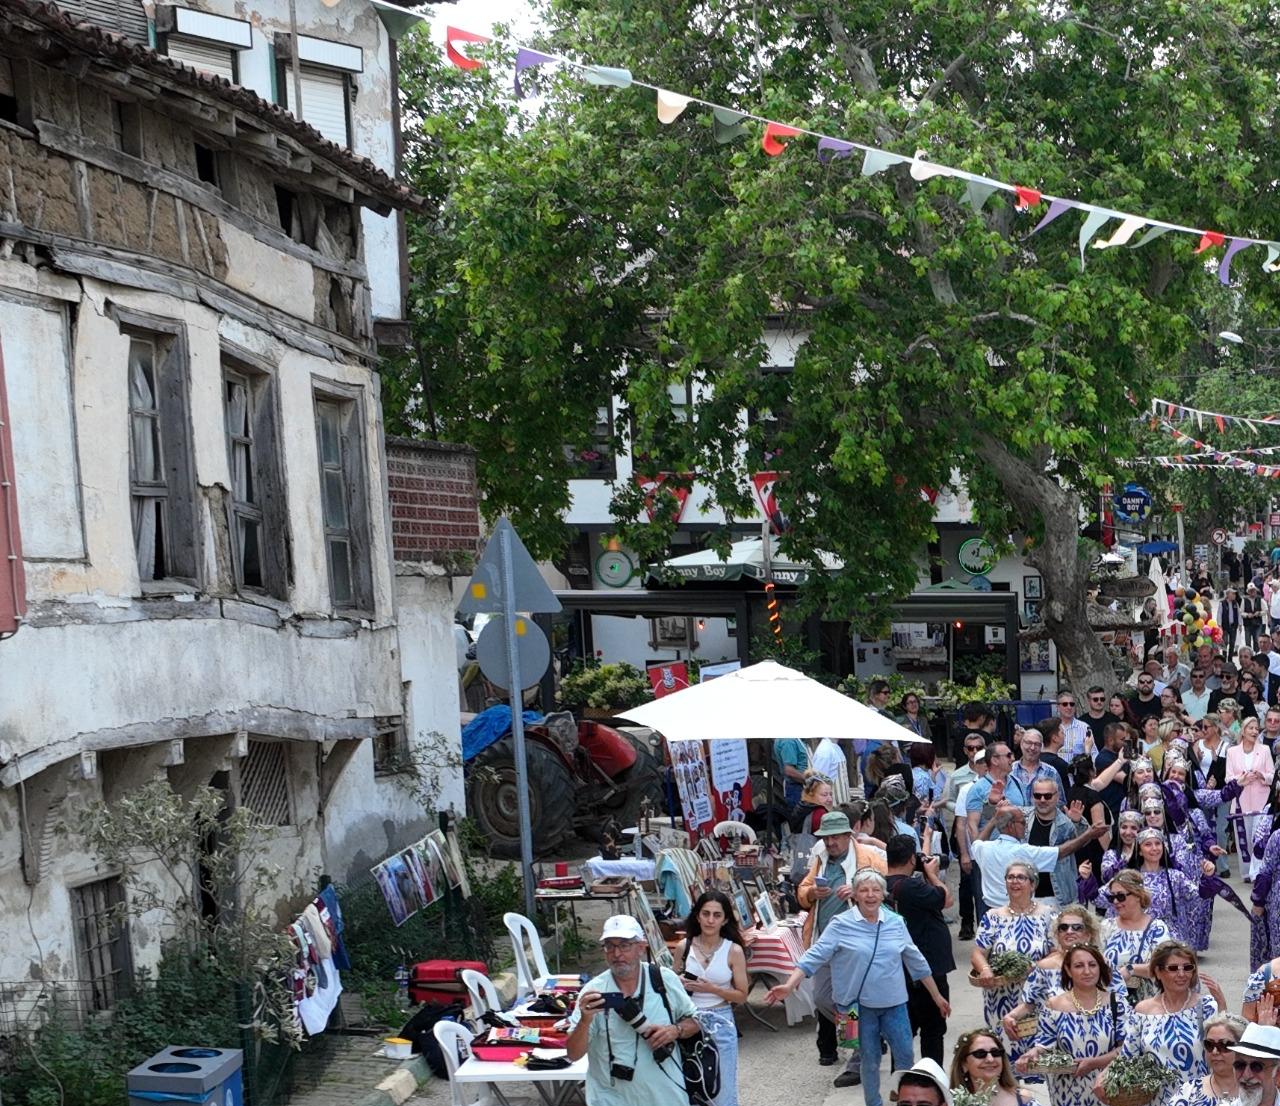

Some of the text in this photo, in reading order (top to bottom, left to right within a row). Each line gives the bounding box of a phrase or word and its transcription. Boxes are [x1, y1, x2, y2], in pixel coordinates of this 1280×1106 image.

[1122, 497, 1144, 505] DANNY
[703, 565, 726, 578] Boy
[755, 567, 799, 583] Dnny
